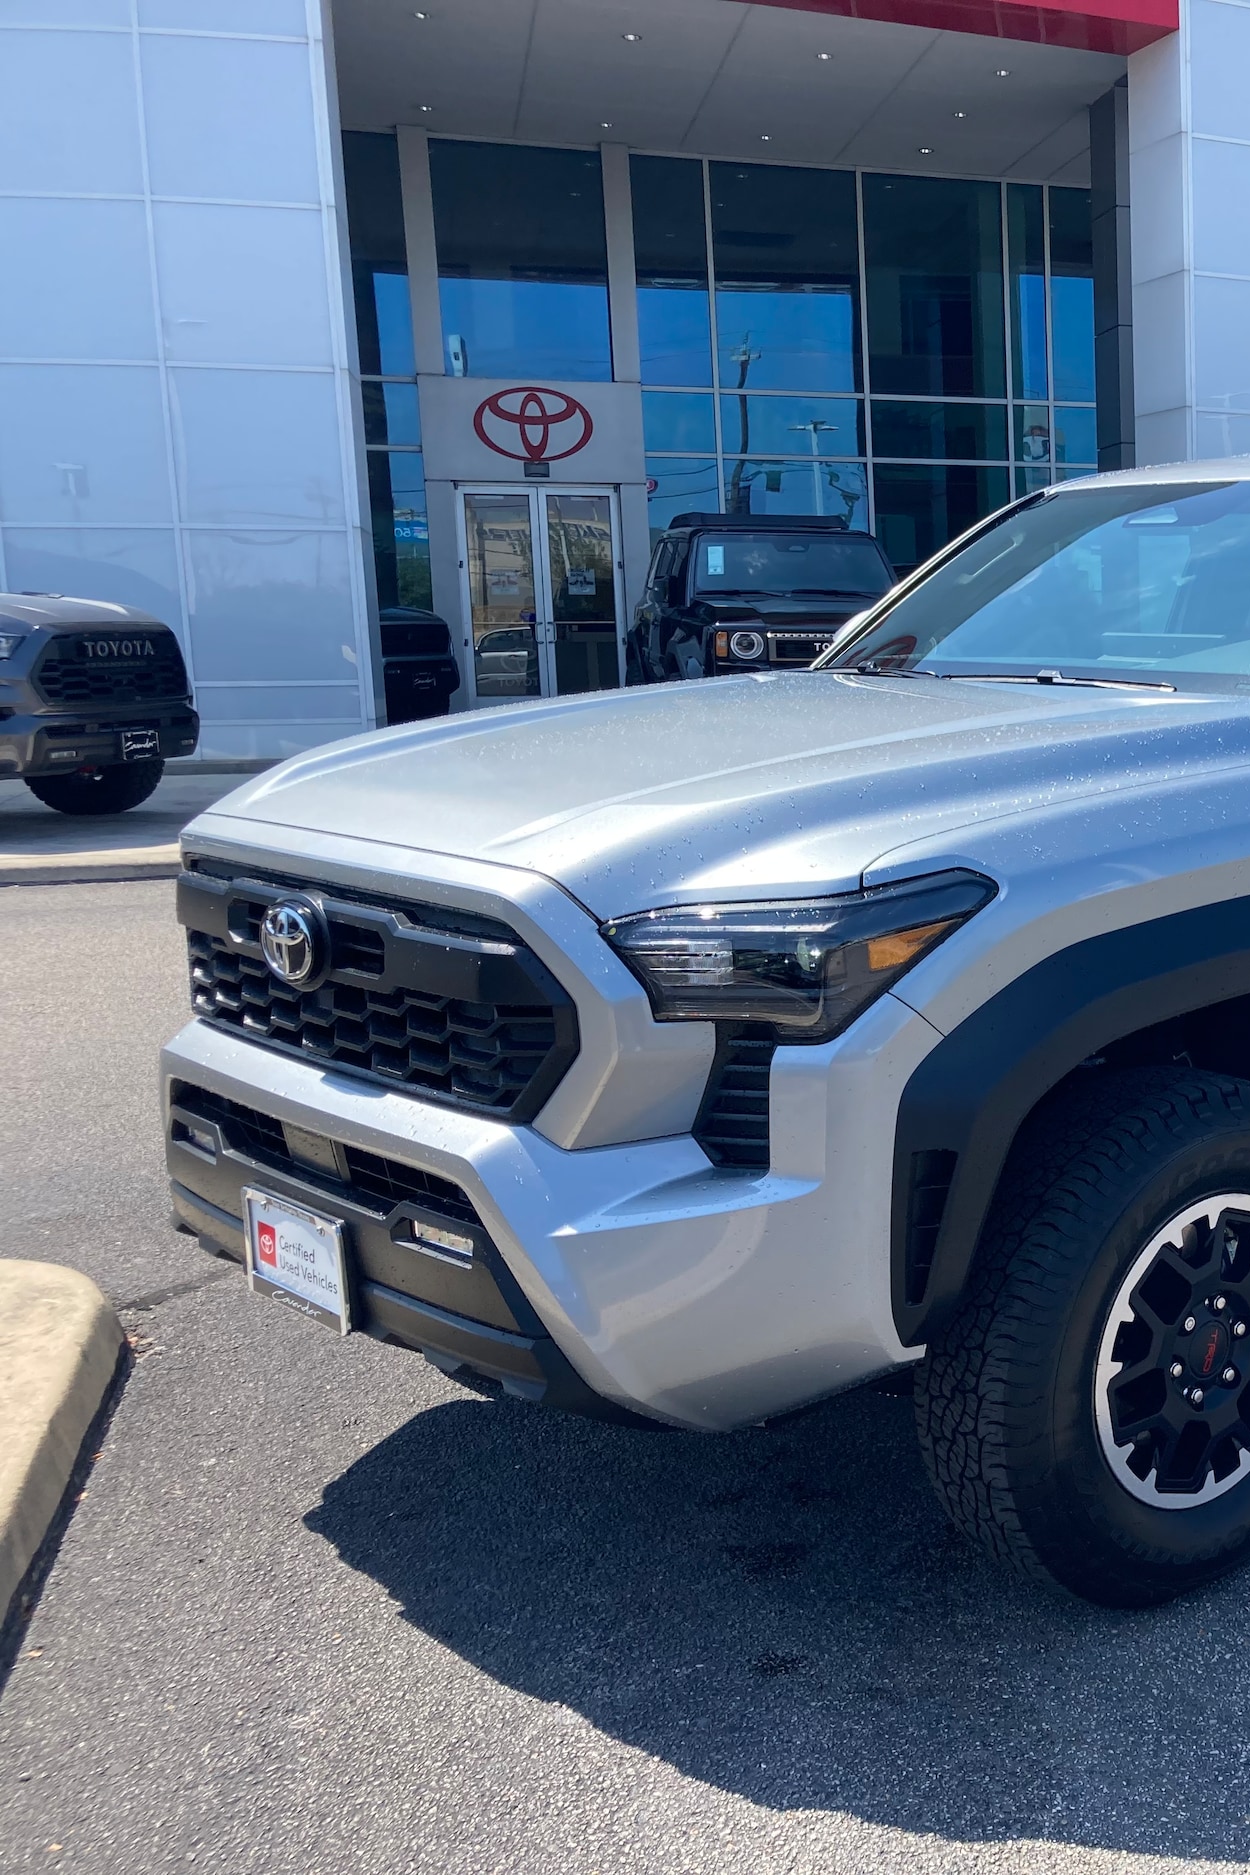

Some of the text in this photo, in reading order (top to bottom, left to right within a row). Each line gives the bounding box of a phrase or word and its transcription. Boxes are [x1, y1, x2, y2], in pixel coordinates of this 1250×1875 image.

[83, 640, 155, 657] TOYOTA
[279, 1236, 315, 1264] Certified
[279, 1253, 338, 1295] Used Vehicles
[1202, 1328, 1219, 1373] TRD
